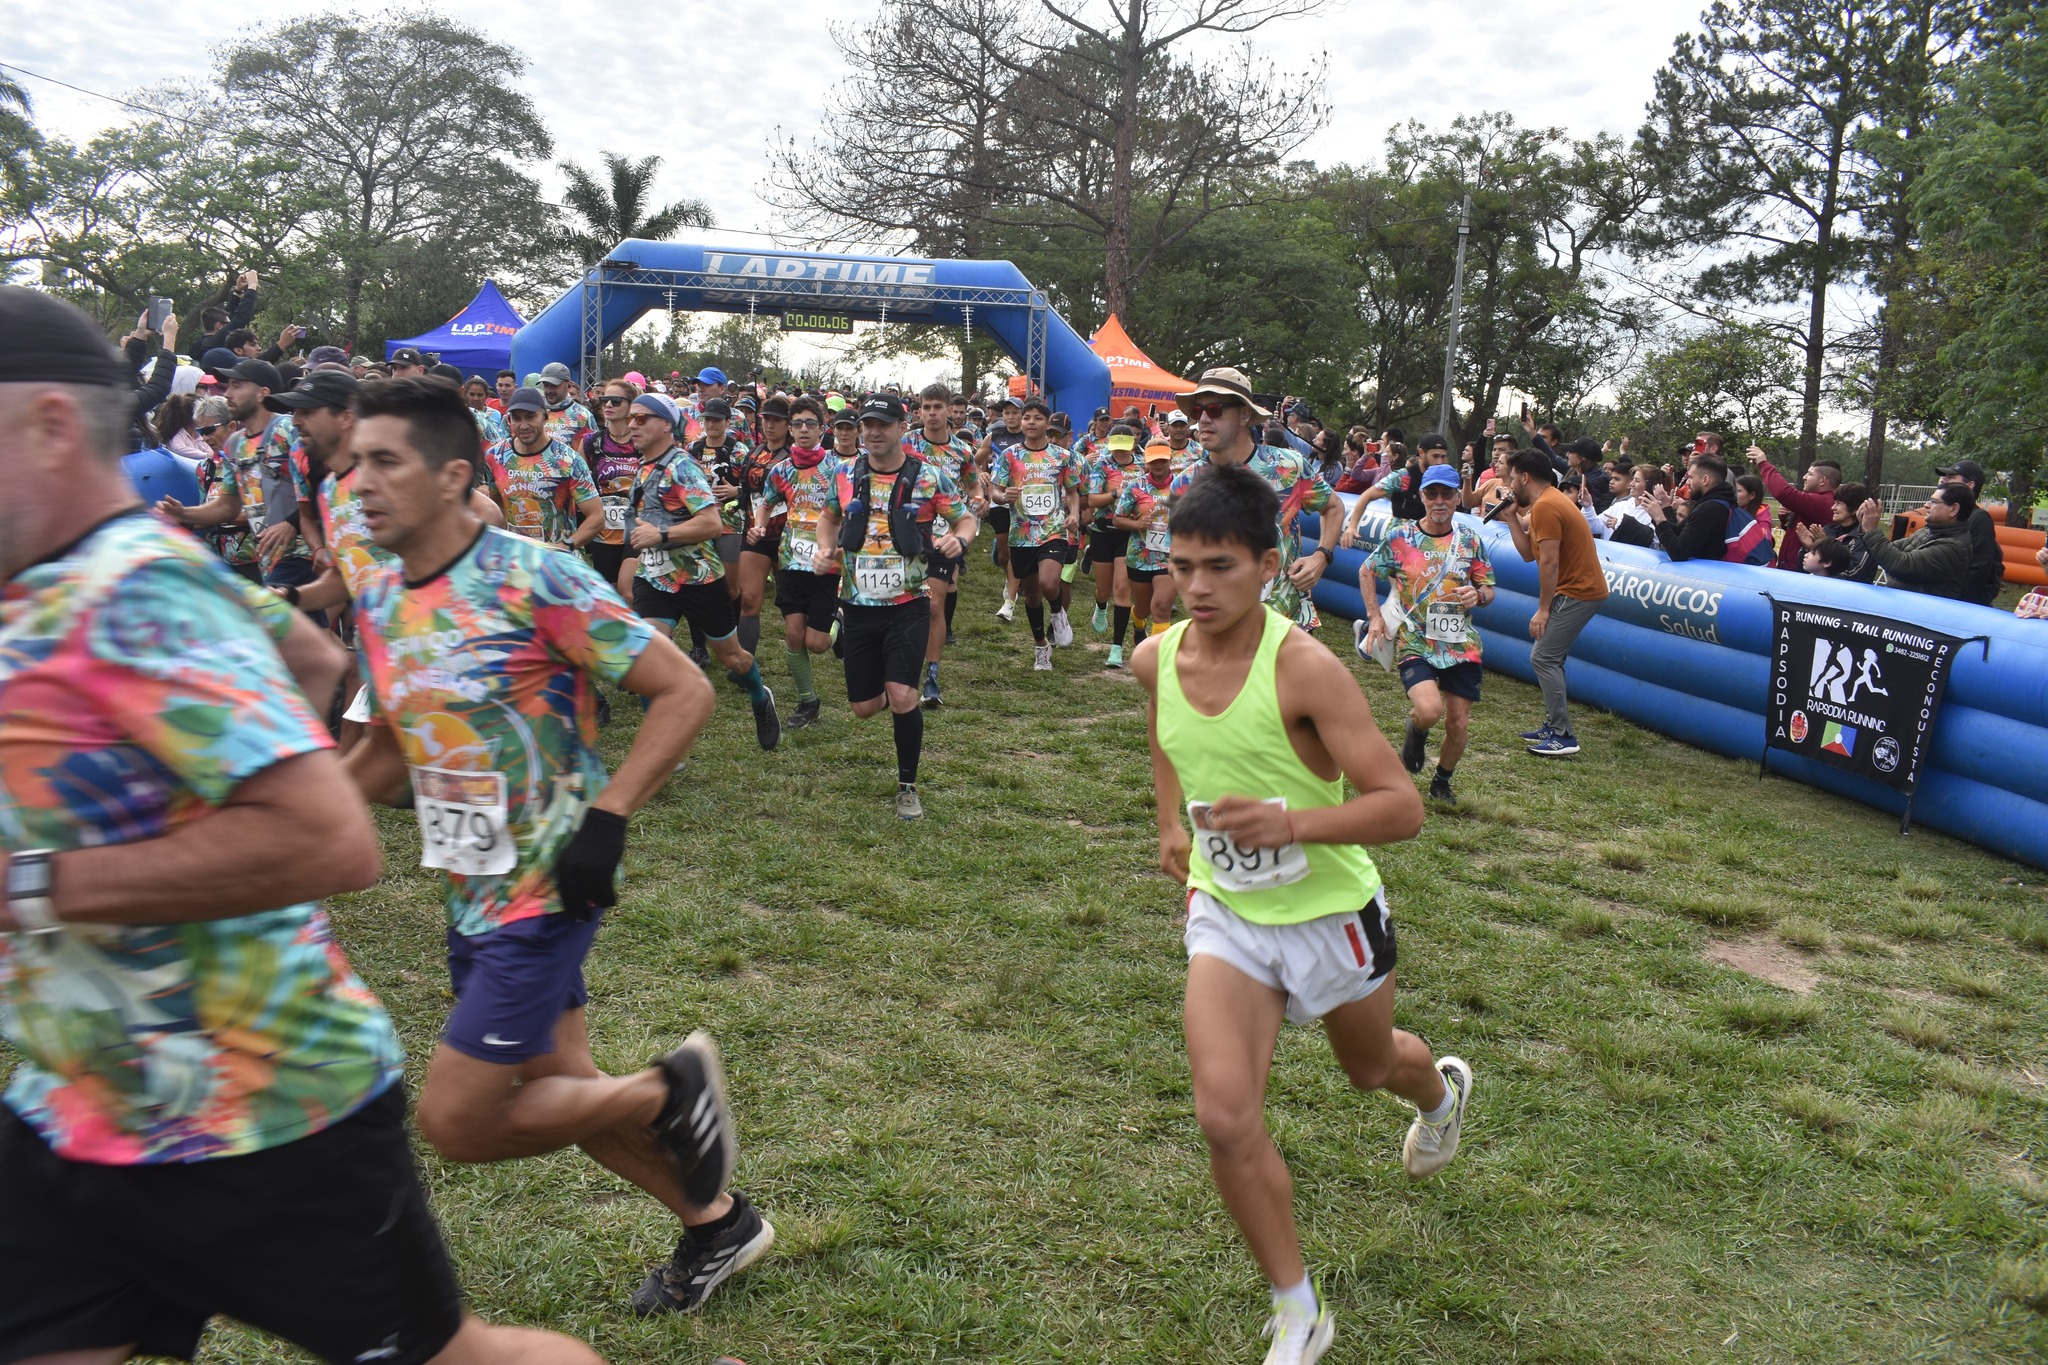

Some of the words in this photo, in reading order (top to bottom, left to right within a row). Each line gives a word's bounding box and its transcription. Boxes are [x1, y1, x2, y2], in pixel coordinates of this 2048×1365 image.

[705, 255, 932, 294] LAPTIME
[451, 323, 519, 336] LAPTIM
[602, 466, 615, 476] LA
[1025, 495, 1052, 508] 546
[860, 573, 902, 588] 1143
[1602, 570, 1722, 616] RÁRQUICOS
[1430, 616, 1466, 633] 1032
[1660, 614, 1720, 645] Salud
[1795, 611, 1841, 628] RUNNING
[1851, 621, 1879, 638] TRAIL
[1882, 628, 1934, 651] RUNNING
[1806, 699, 1848, 721] RAPSODIA
